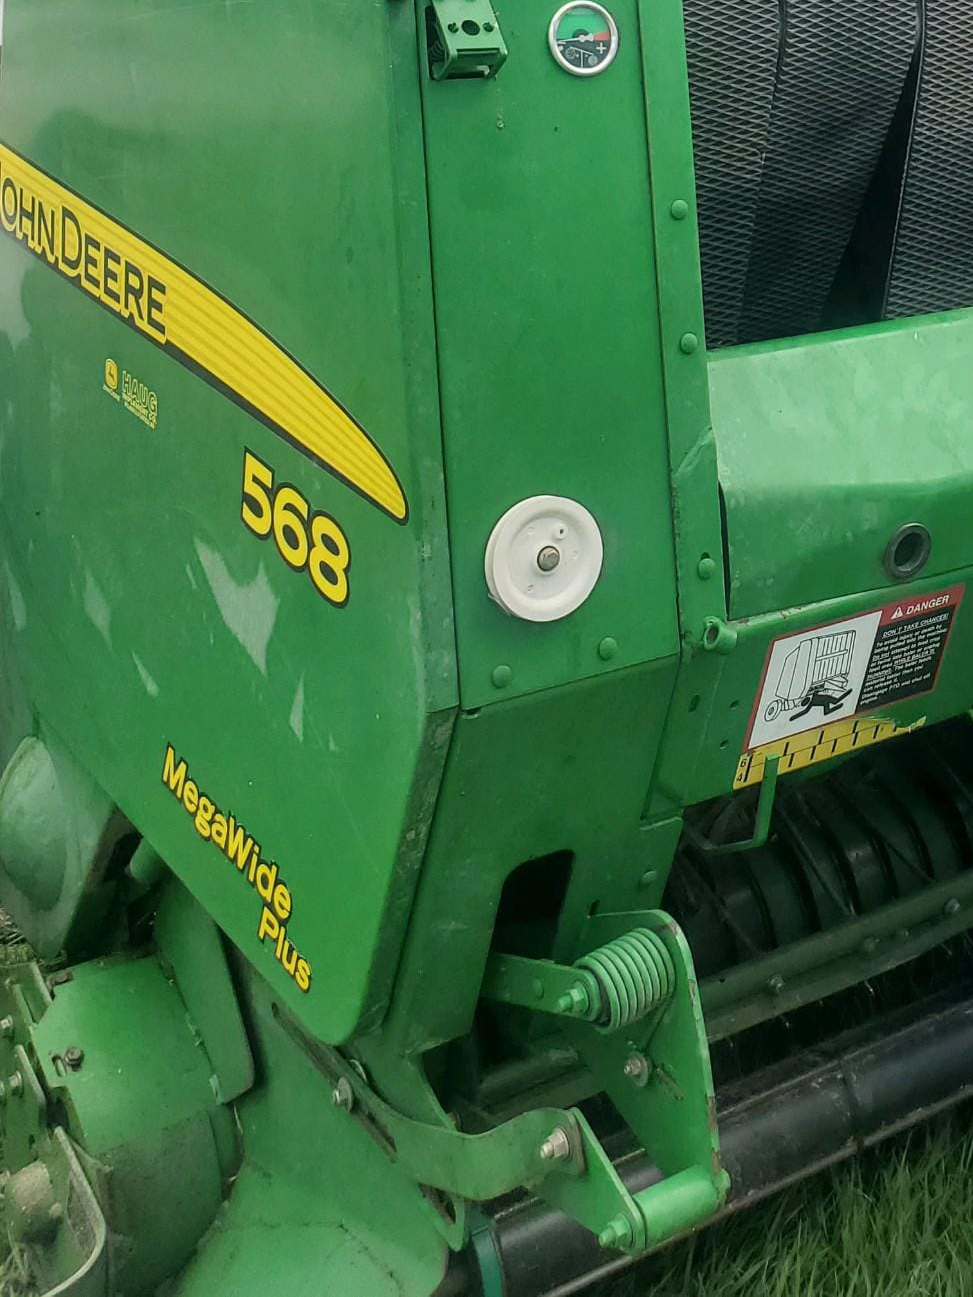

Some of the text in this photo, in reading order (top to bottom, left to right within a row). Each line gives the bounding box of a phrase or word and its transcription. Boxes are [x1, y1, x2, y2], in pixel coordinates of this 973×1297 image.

[0, 160, 167, 337] OHN DEERE
[122, 370, 158, 417] HAUG
[241, 446, 351, 608] 568
[906, 594, 950, 615] DANGER
[162, 743, 293, 921] MegaWide
[257, 905, 312, 992] Plus
